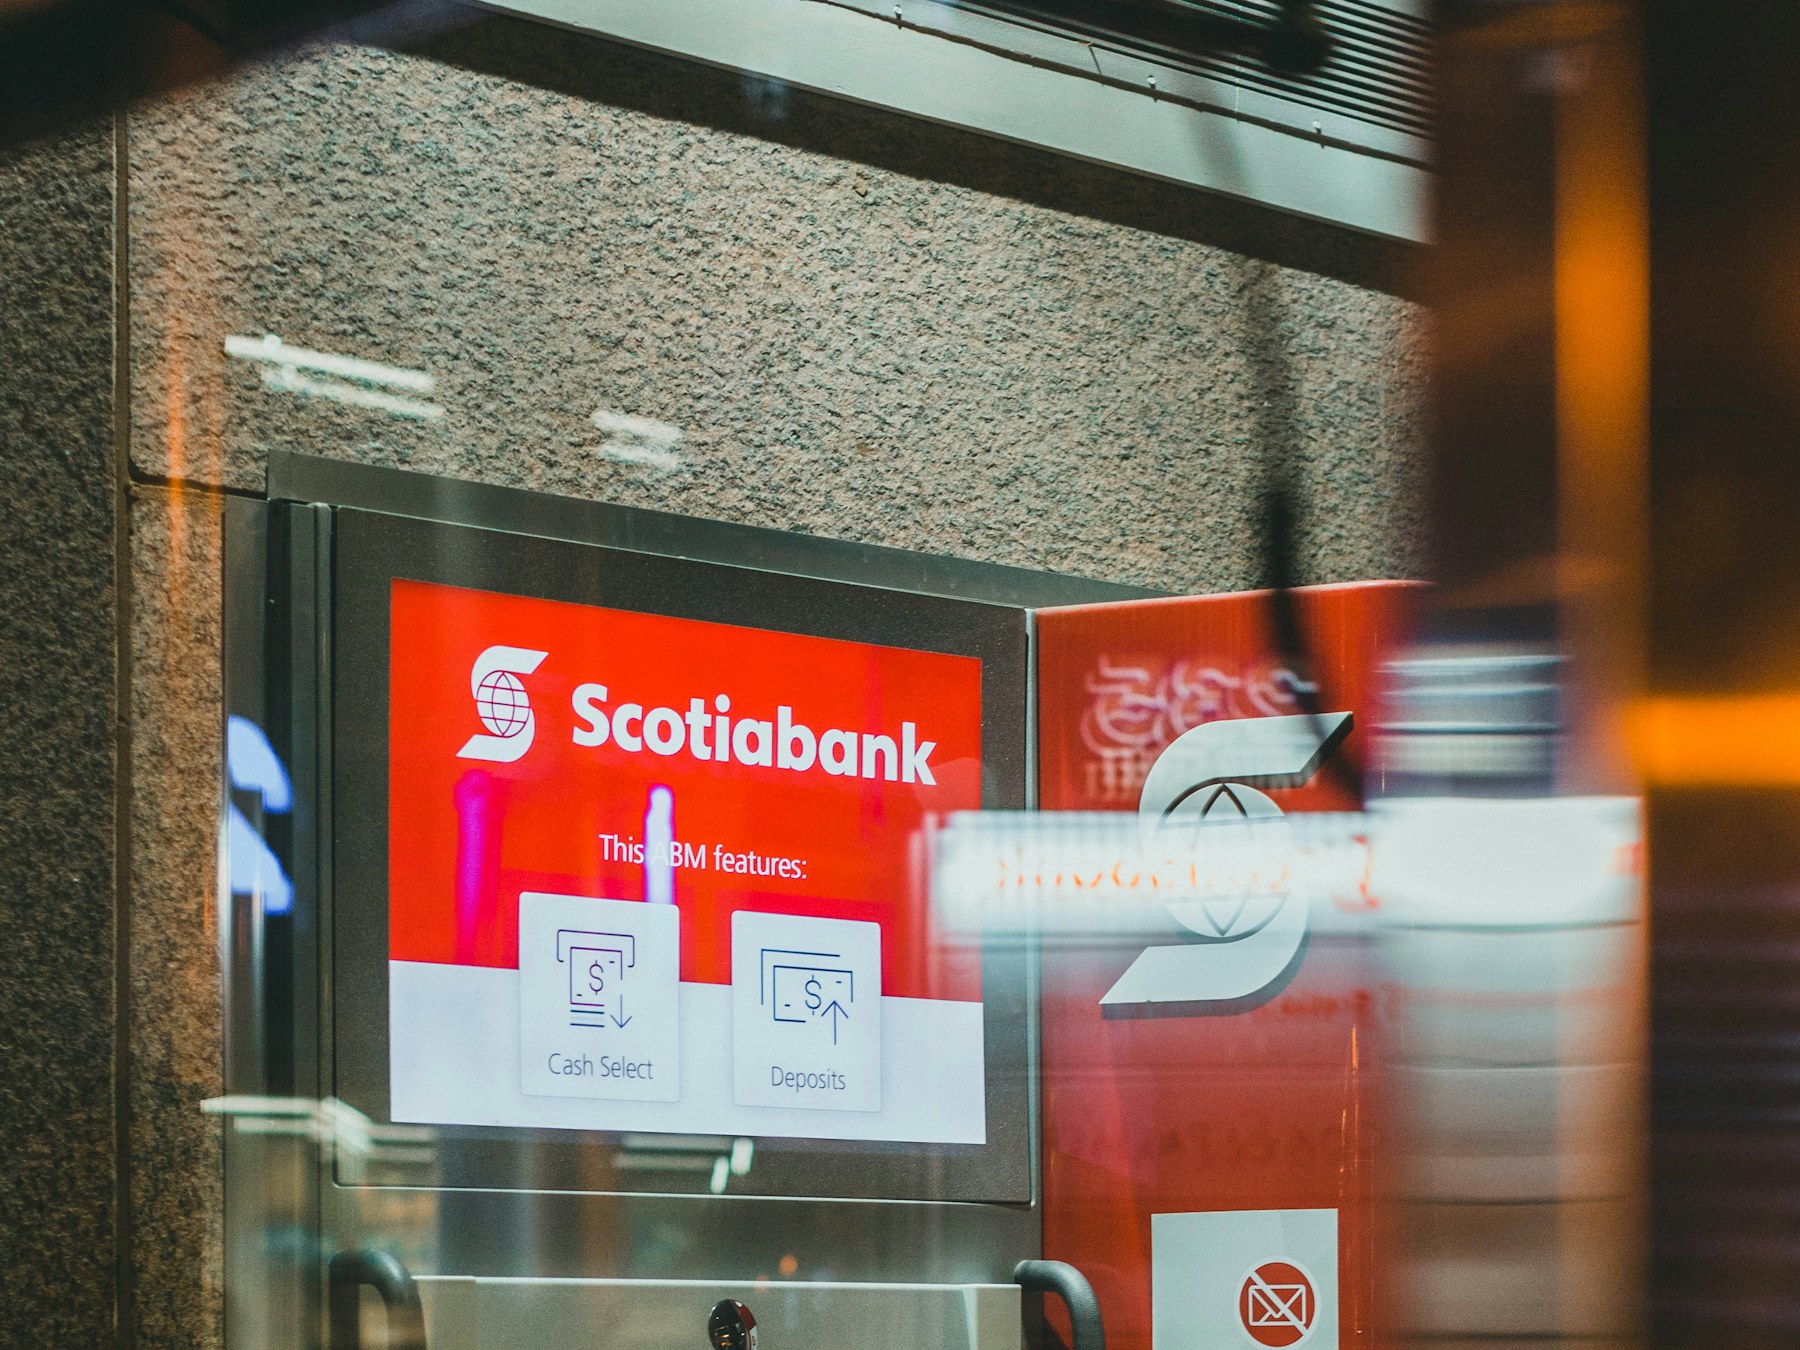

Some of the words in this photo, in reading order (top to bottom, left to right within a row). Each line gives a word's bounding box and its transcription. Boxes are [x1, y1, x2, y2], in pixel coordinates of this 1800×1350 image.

[571, 683, 937, 786] Scotiabank
[599, 833, 645, 865] This
[651, 839, 706, 871] ABM
[713, 843, 808, 880] features:
[547, 1052, 594, 1078] Cash
[600, 1056, 654, 1082] Select
[770, 1065, 847, 1092] Deposits
